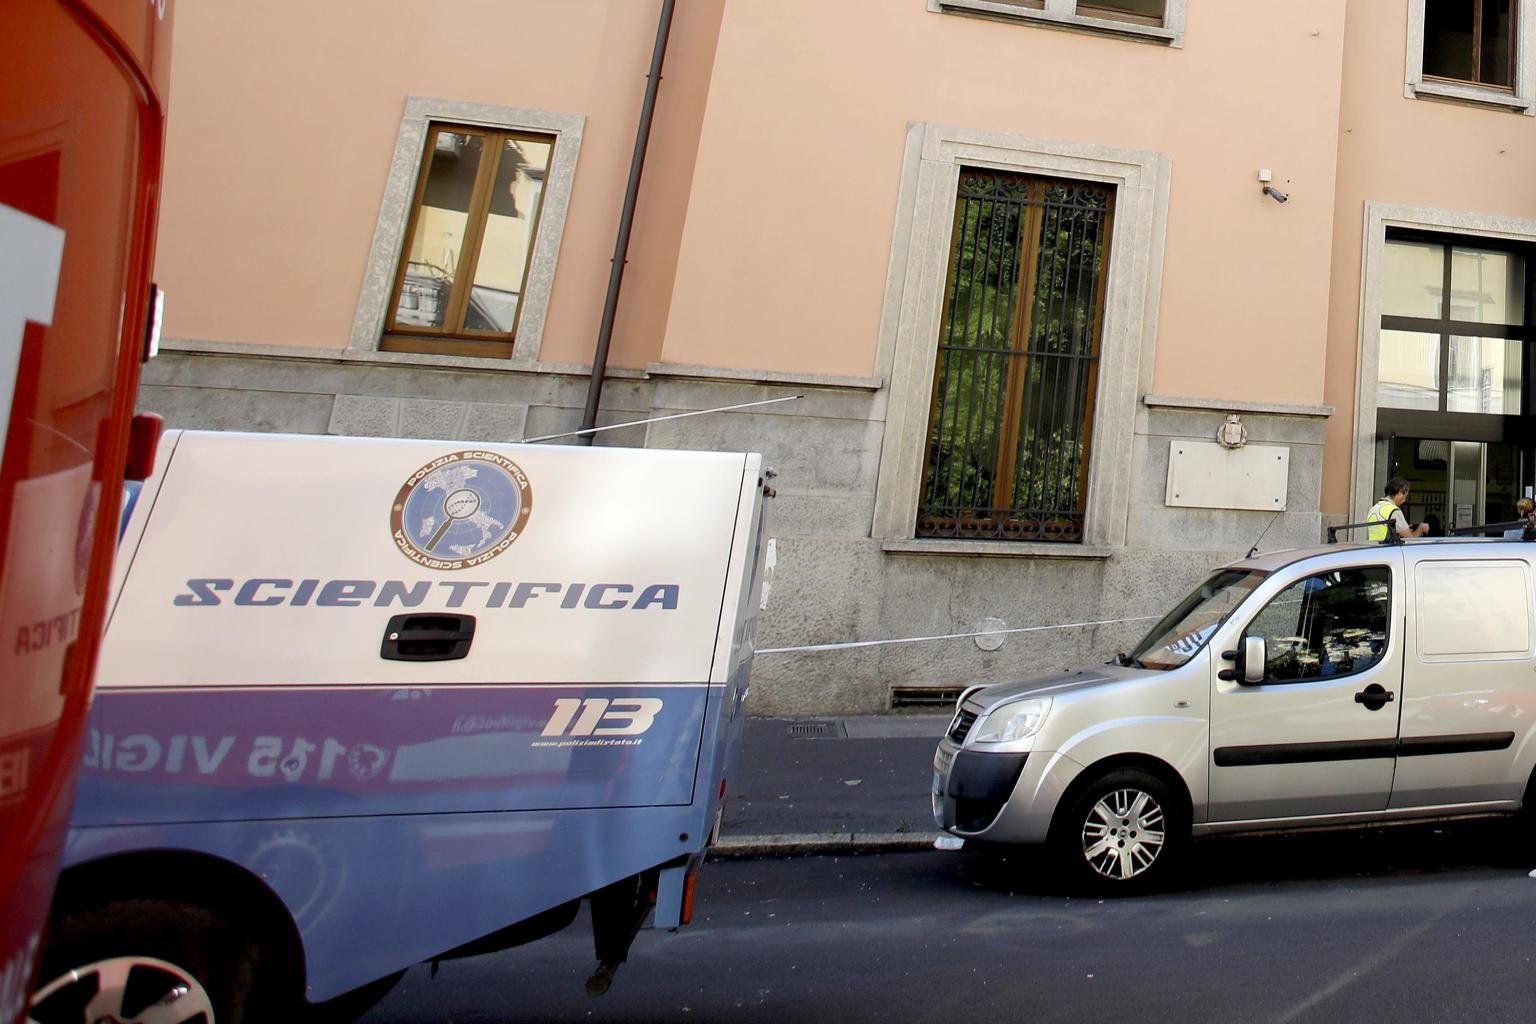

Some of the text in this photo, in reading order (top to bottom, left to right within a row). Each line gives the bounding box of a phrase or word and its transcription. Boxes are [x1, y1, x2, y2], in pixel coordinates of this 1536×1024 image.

[407, 451, 529, 490] POLIZIA SCIENTIFICA
[393, 529, 518, 570] POLIZIA SCIENTIFICA
[540, 697, 664, 737] 113
